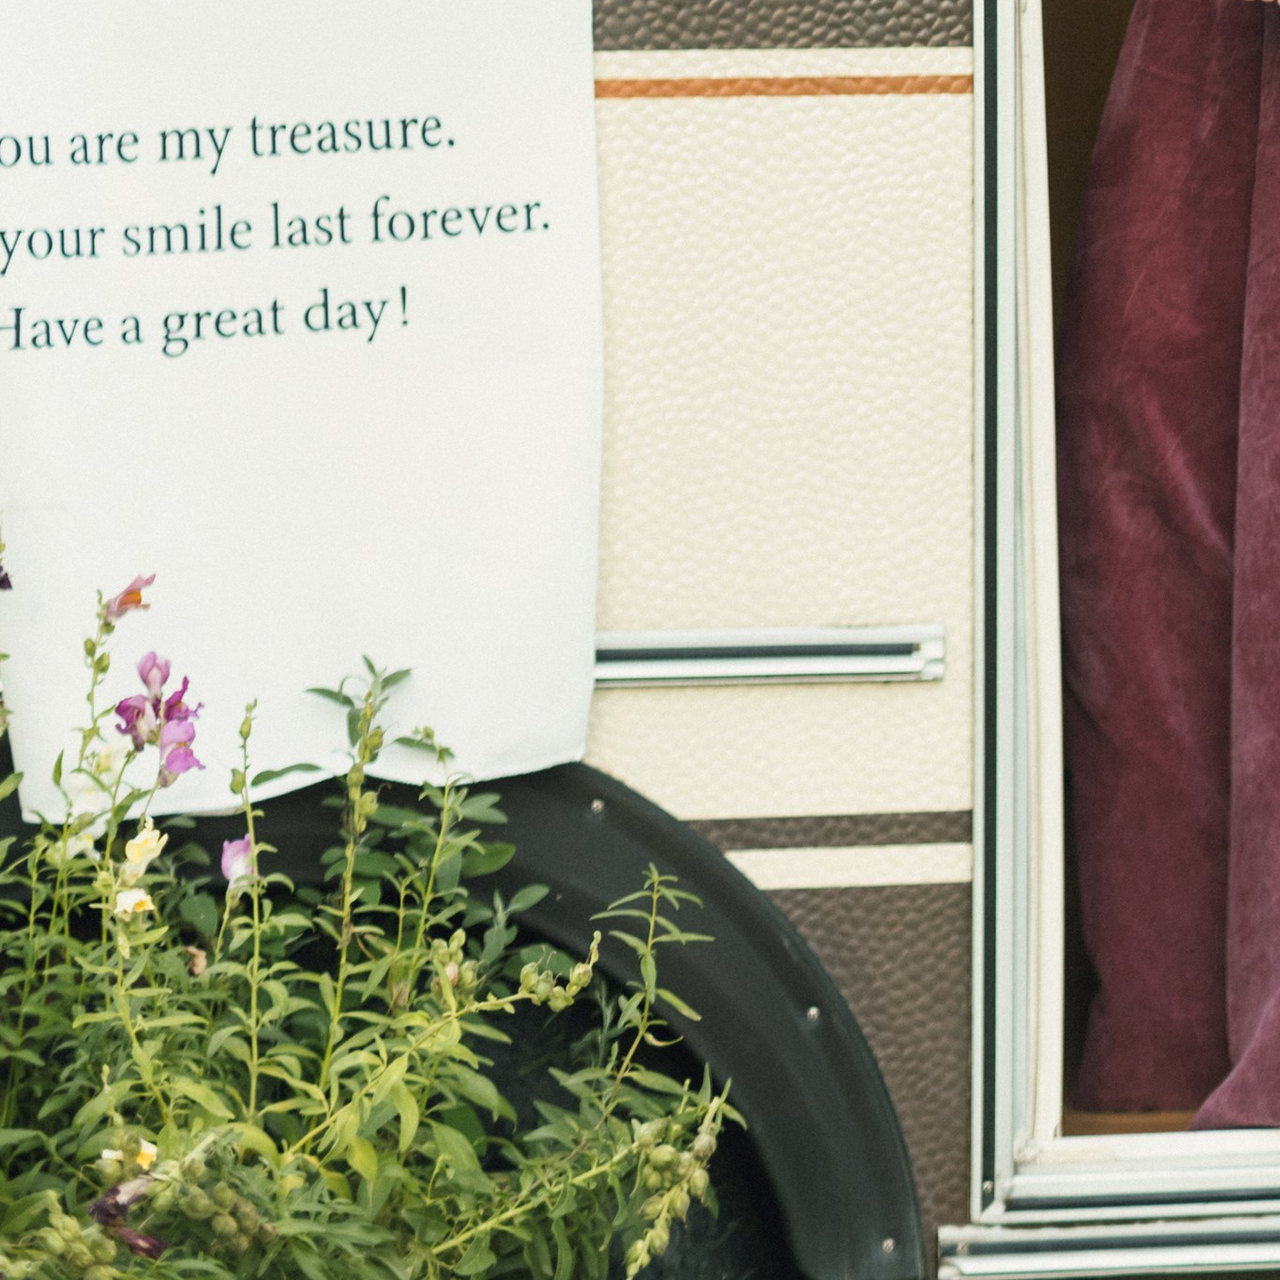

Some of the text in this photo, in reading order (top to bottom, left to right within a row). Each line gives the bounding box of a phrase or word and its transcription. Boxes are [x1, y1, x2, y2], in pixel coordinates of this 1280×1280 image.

[0, 115, 456, 177] ou are my treasure.
[0, 194, 551, 278] your smile last forever.
[120, 315, 144, 346] a
[161, 298, 285, 359] great
